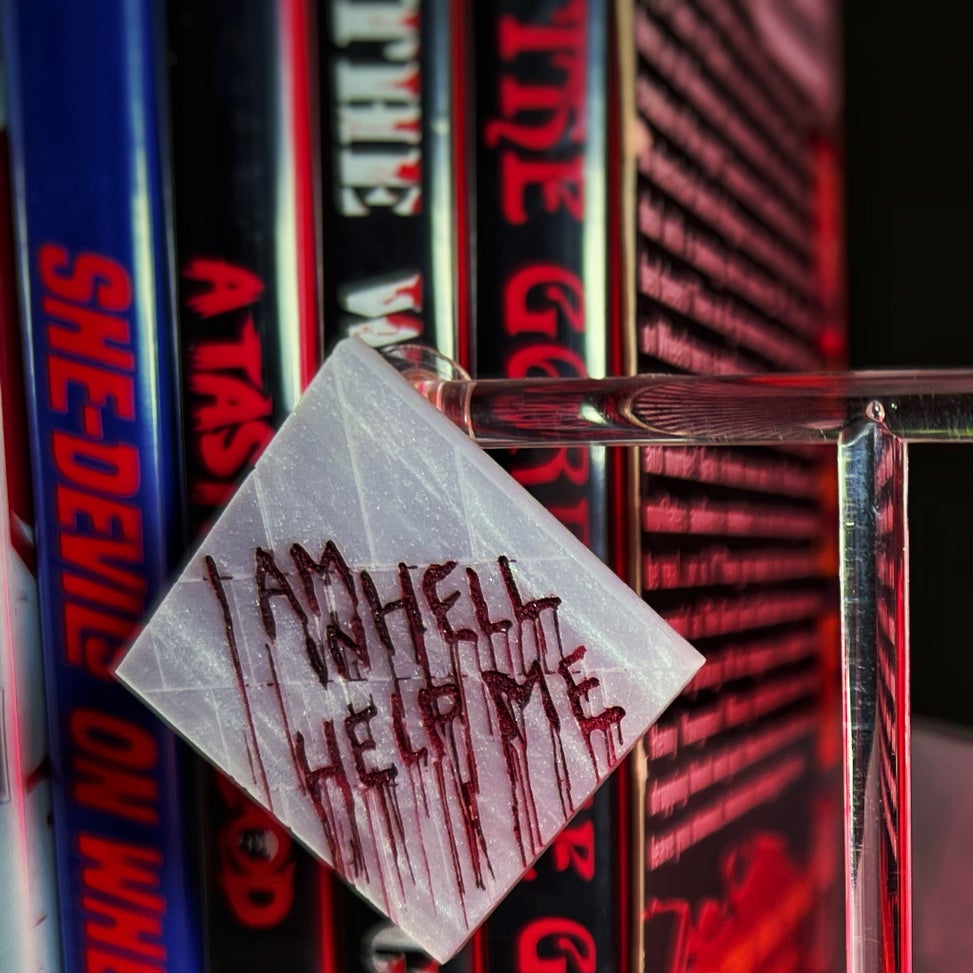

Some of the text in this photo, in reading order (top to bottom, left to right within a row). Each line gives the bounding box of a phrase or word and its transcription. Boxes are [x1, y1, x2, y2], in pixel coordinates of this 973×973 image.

[336, 0, 421, 216] THE
[485, 0, 586, 226] THE
[184, 257, 264, 320] A
[359, 555, 562, 668] HELL
[70, 706, 160, 824] ON
